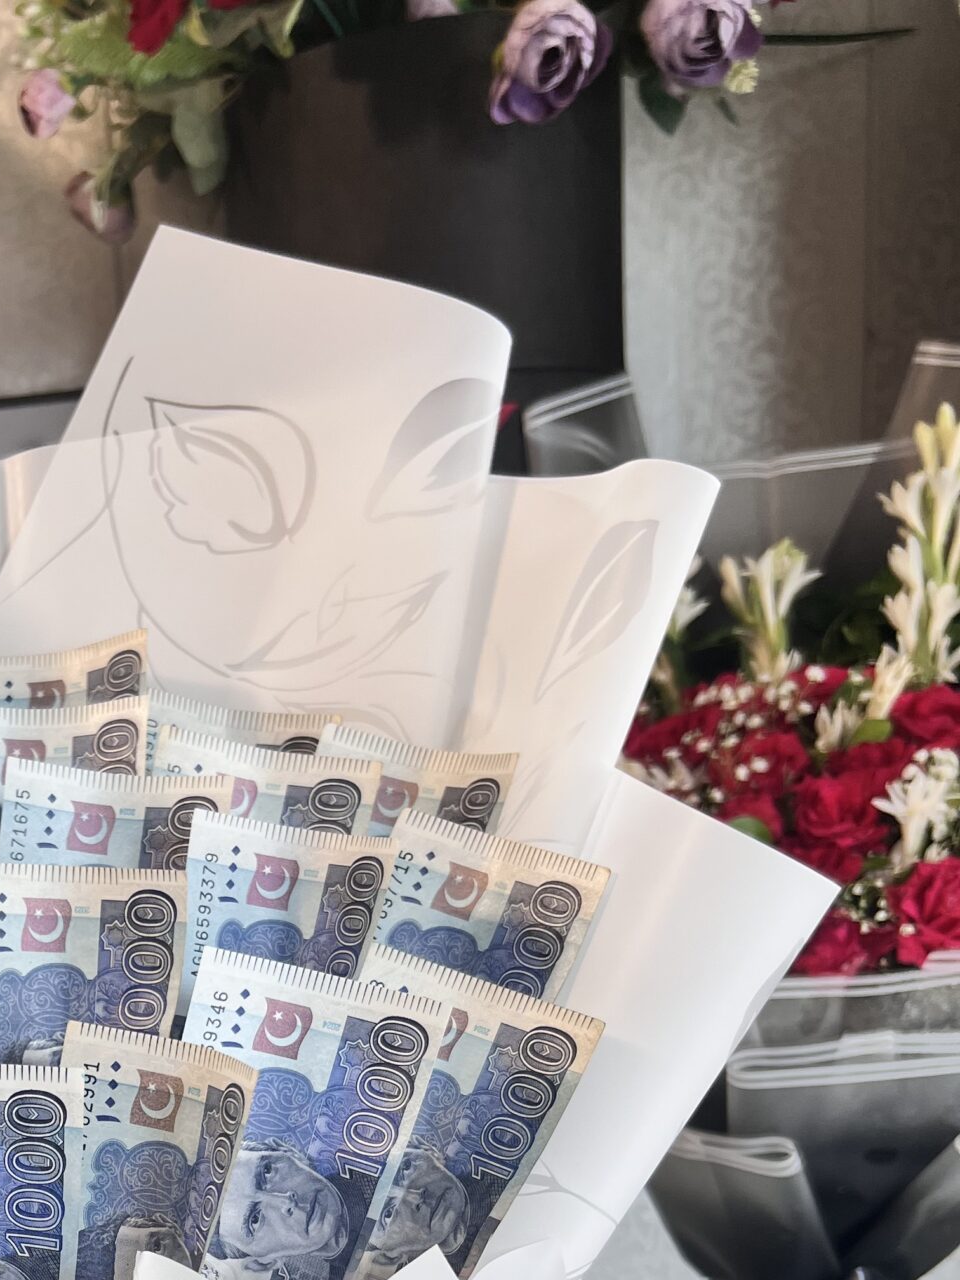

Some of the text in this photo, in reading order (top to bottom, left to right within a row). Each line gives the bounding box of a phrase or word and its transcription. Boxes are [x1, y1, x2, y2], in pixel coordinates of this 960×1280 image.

[118, 890, 178, 1030] 000
[3, 1090, 65, 1257] 1000
[334, 1017, 428, 1180] 1000
[470, 1027, 577, 1181] 1000
